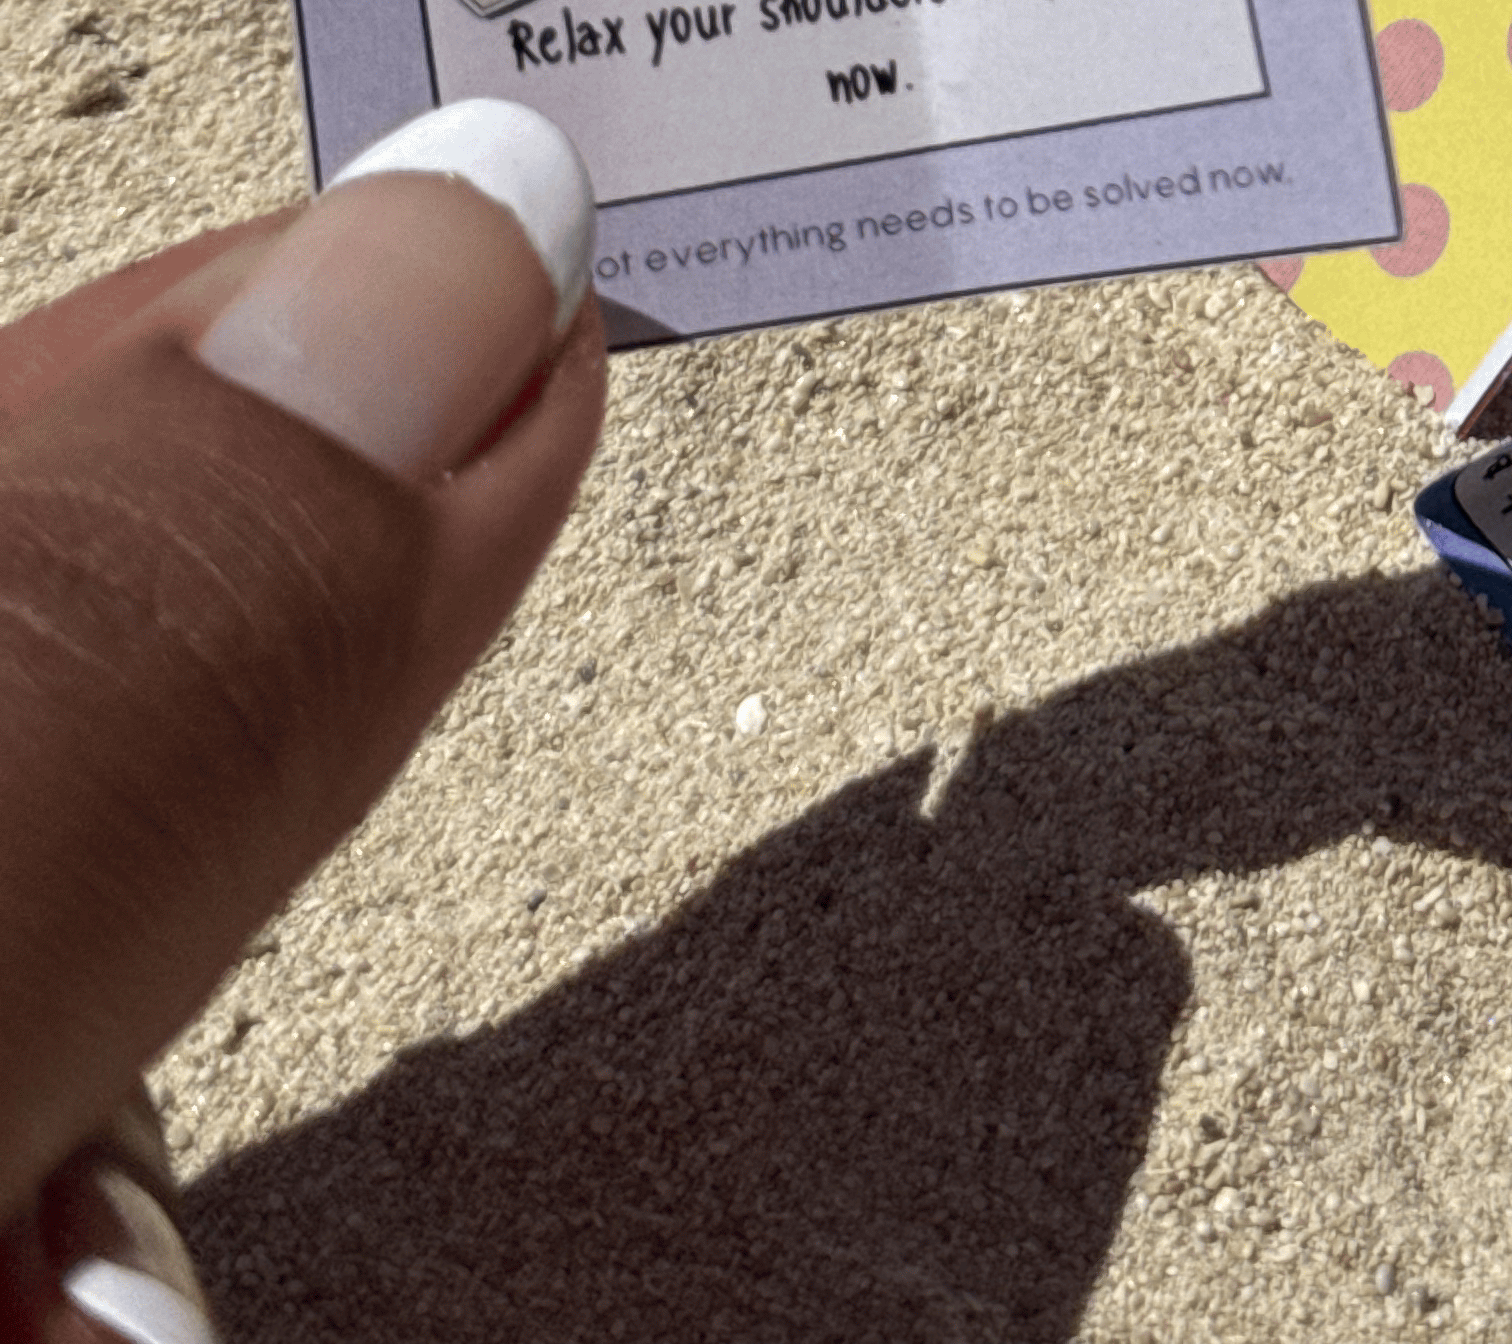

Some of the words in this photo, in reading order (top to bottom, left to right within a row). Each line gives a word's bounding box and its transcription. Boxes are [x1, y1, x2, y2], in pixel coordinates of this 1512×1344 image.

[508, 6, 626, 72] Relax
[646, 1, 736, 68] your
[826, 58, 915, 103] now.
[594, 246, 630, 282] ot
[646, 220, 846, 275] everything
[857, 200, 975, 241] needs
[984, 193, 1018, 220] to
[1028, 184, 1074, 216] be
[1086, 165, 1202, 210] solved
[1208, 156, 1295, 193] now.
